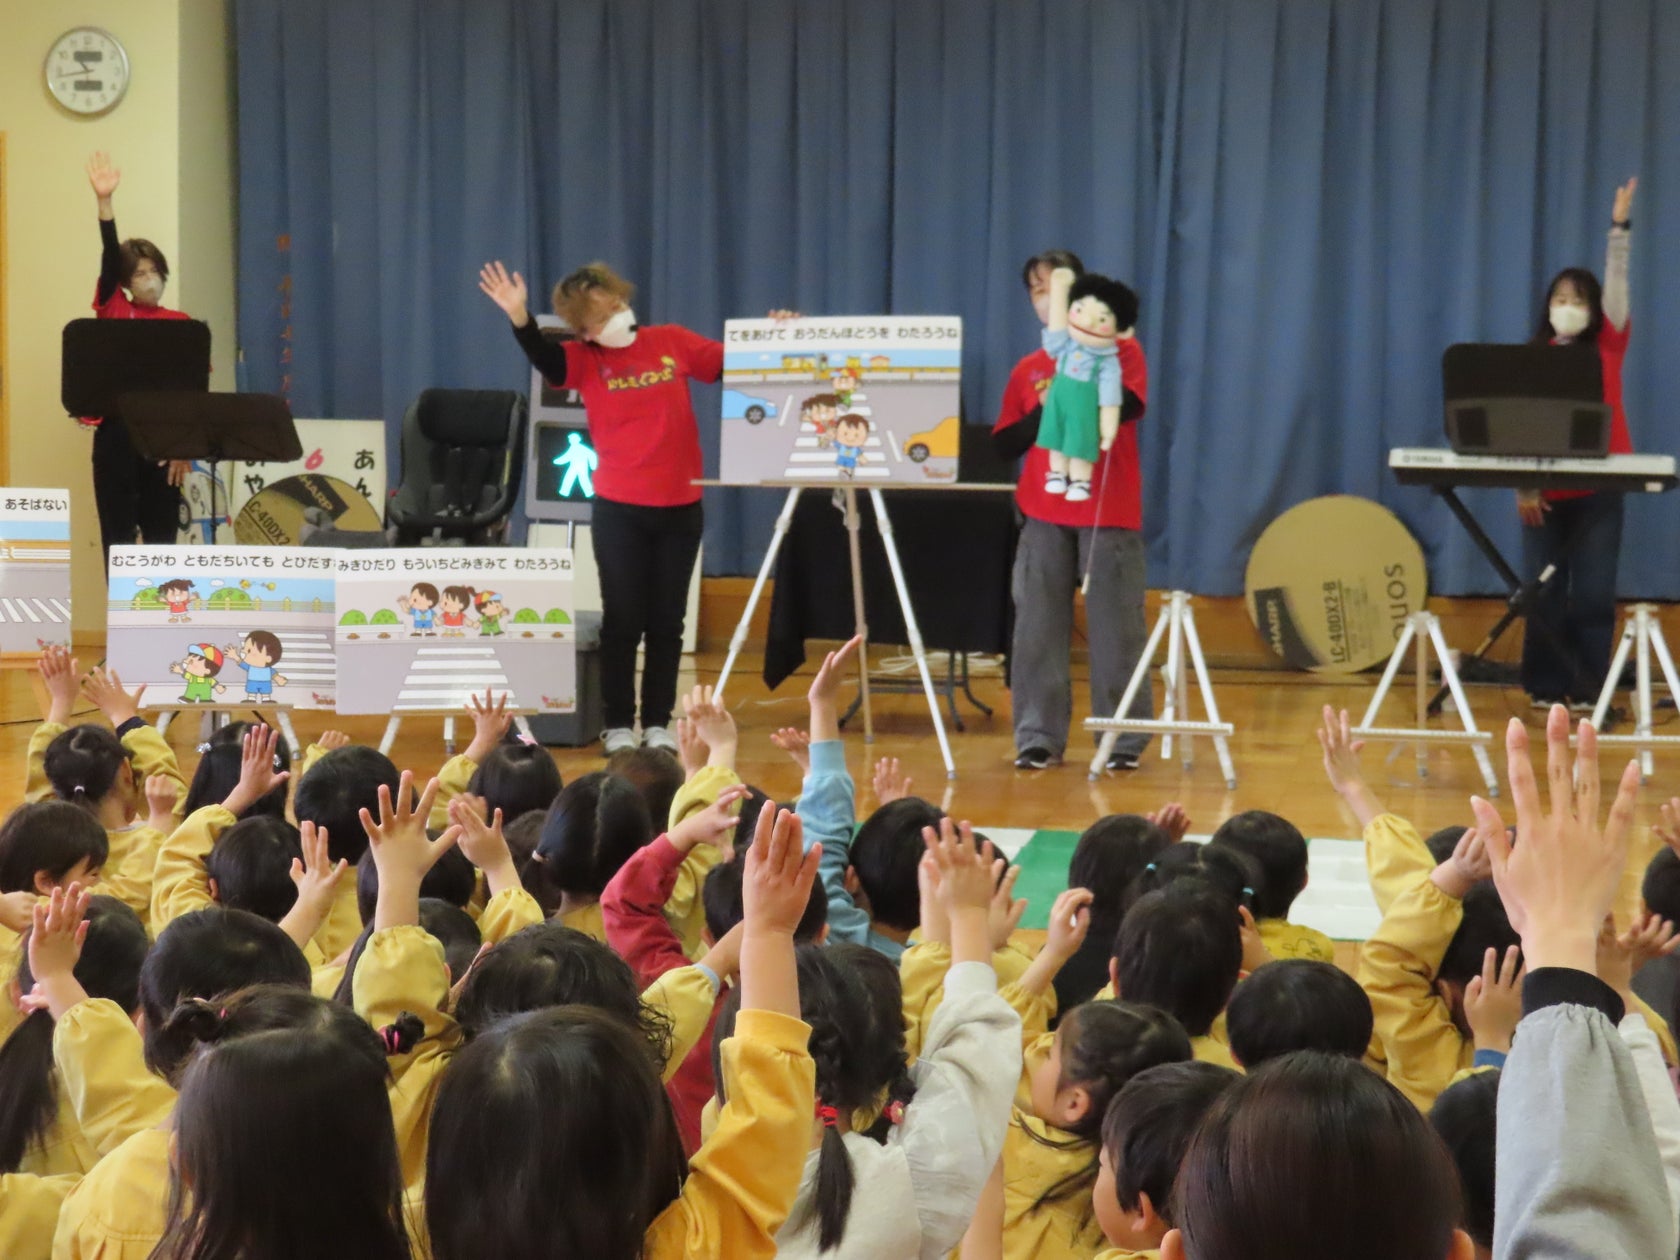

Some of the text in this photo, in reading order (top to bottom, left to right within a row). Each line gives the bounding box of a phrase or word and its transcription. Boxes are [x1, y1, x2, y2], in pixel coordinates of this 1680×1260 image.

[728, 326, 959, 342] てをあげて おうだんほどうを わたろうね
[304, 448, 325, 470] 6
[296, 474, 334, 513] HARP
[4, 498, 68, 511] あそばない
[111, 554, 336, 569] むこうがわ ともだちいても とびだす
[337, 557, 572, 572] みぎひだり もういちどみぎみて わたろうね
